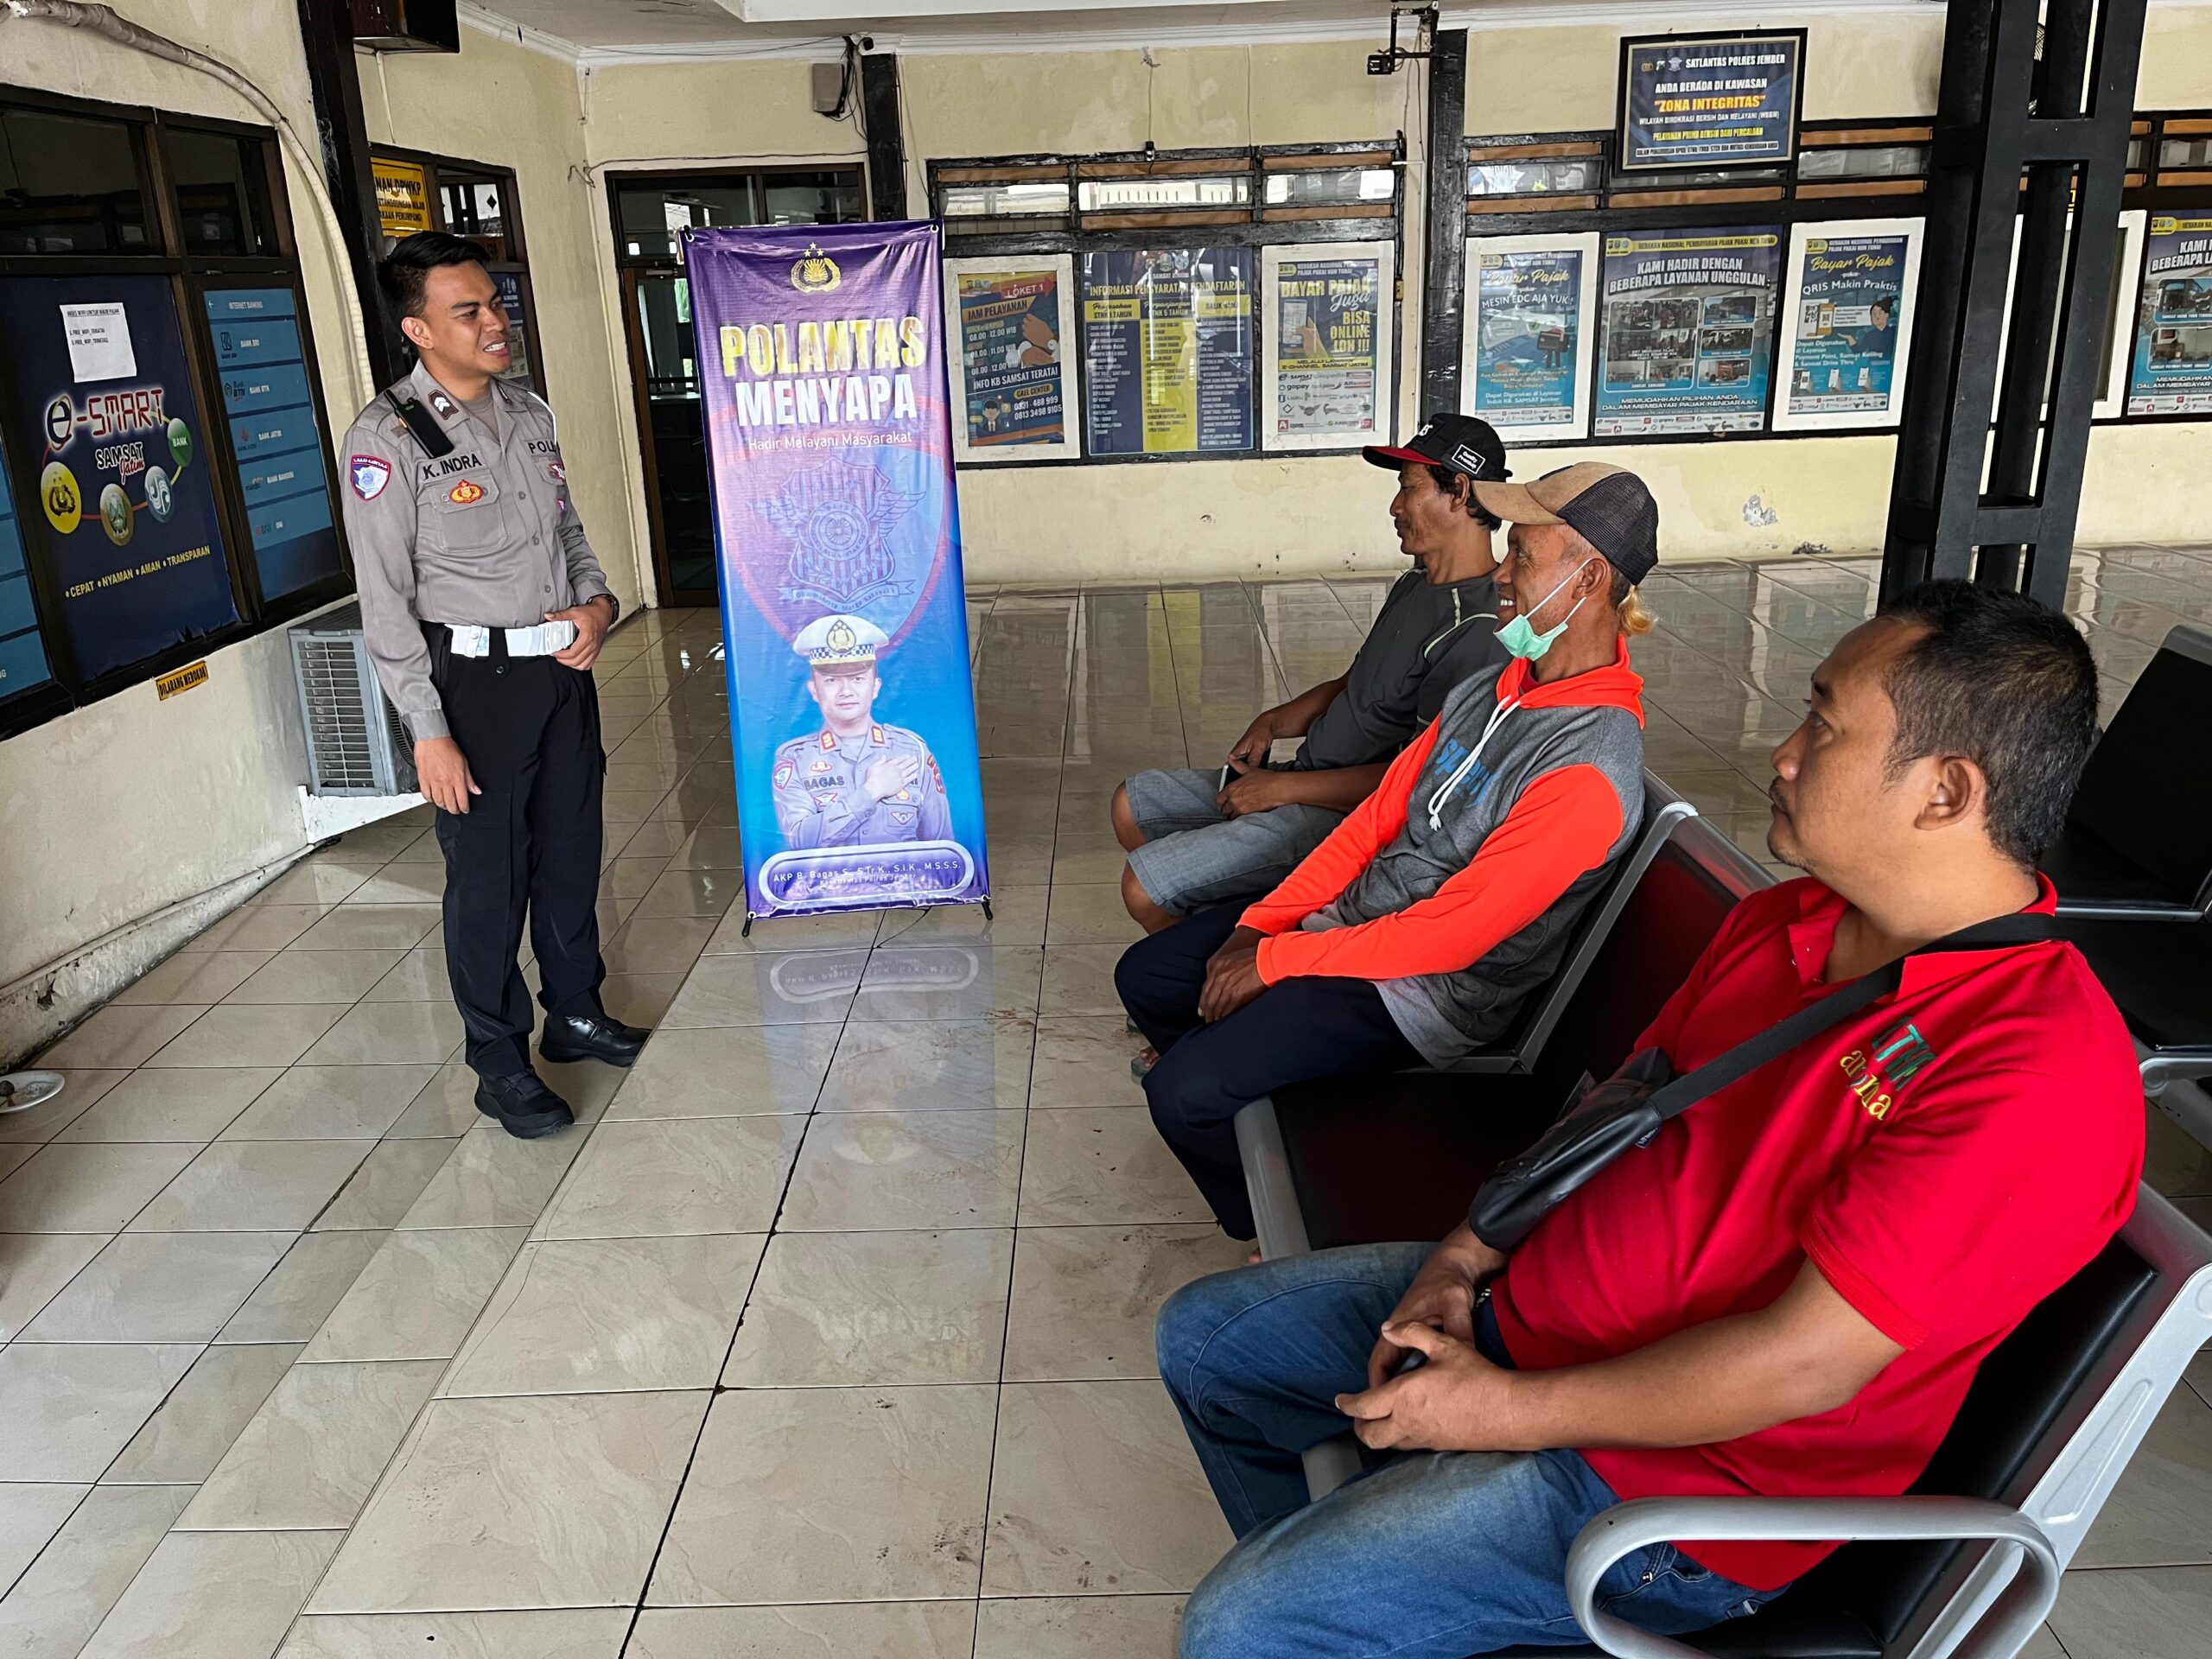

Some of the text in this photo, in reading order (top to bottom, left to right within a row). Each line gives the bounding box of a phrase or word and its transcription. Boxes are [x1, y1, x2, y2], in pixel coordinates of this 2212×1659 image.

[1686, 54, 1786, 68] SATLANTAS POLRES JEMBER
[1656, 79, 1767, 93] ANDA BERADA DI KAWASAN
[1654, 95, 1765, 112] "ZONA INTEGRITAS"
[1664, 115, 1694, 124] BIROKRASI
[1696, 114, 1716, 123] BERSIH
[2180, 239, 2207, 253] KAMI
[1637, 257, 1743, 275] KAMI HADIR DENGAN
[1810, 254, 1895, 273] Bayar Pajak
[2152, 252, 2202, 271] BEBERAPA
[1531, 270, 1570, 285] Pajak
[1609, 271, 1765, 293] BEBERAPA LAYANAN UNGGULAN
[1007, 284, 1037, 296] LOKET
[1090, 283, 1133, 296] INFORMASI
[1281, 278, 1370, 297] BAYAR PAJAK
[1802, 279, 1897, 296] QRIS Makin Praktis
[1330, 292, 1371, 312] Juga
[1482, 294, 1567, 308] MESIN EDC AJA YUK
[968, 300, 1027, 321] JAM PELAYANAN
[1343, 310, 1370, 324] BISA
[990, 328, 1005, 337] 12.00
[1330, 325, 1370, 340] ONLINE
[720, 315, 927, 378] POLANTAS
[1333, 339, 1355, 353] LOH
[974, 366, 1058, 390] INFO KB SAMSAT TERATAI
[1016, 385, 1051, 397] CALL CENTER
[735, 373, 918, 427] MENYAPA
[47, 389, 162, 446] e-SMART
[173, 437, 188, 448] BANK
[748, 431, 912, 454] Hadir Melayani Masyarakat
[95, 442, 143, 469] SAMSAT
[119, 458, 145, 485] Jatim
[423, 454, 482, 480] K. INDRA
[70, 545, 211, 598] CEPAT NYAMAN AMAN TRANSPARAN
[159, 675, 184, 696] DILARANG
[804, 776, 845, 791] BAGAS
[773, 873, 793, 882] AKP
[810, 870, 838, 880] Bagas
